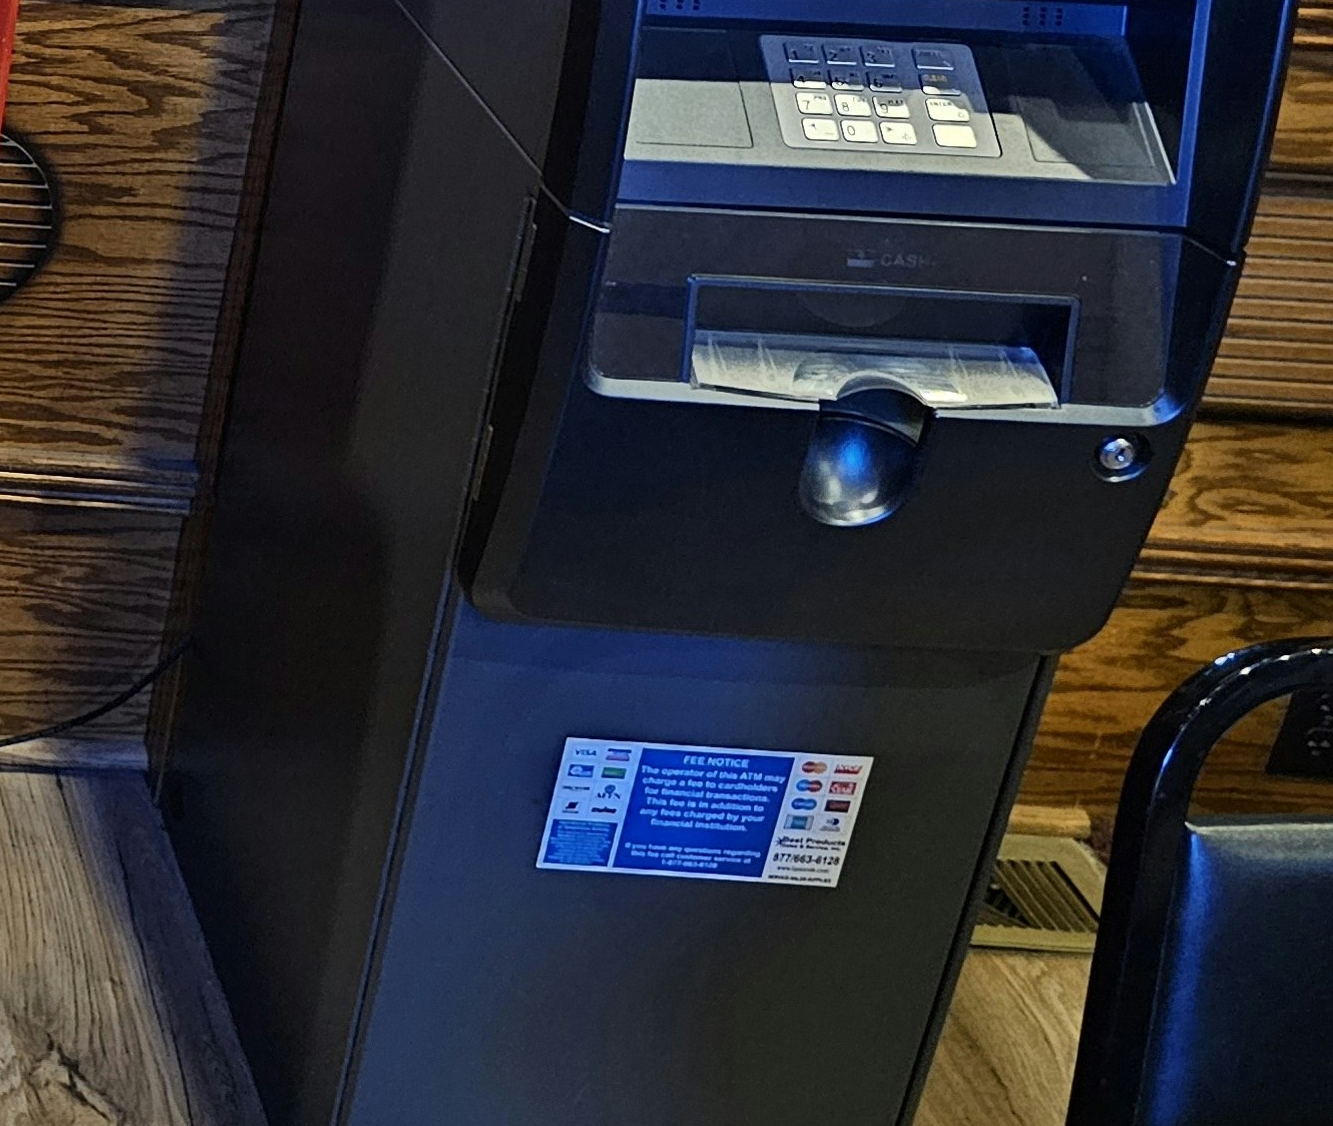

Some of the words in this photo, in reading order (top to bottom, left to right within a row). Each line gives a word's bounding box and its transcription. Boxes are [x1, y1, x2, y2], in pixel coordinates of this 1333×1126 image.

[802, 99, 810, 110] 7
[841, 101, 850, 111] 8
[881, 103, 889, 114] 9
[847, 125, 856, 136] 0
[684, 755, 706, 765] FEE
[707, 757, 750, 769] NOTICE
[641, 765, 659, 774] The
[661, 767, 704, 778] operator
[706, 770, 718, 778] of
[719, 771, 738, 780] this
[740, 772, 763, 781] ATM
[764, 775, 786, 784] may
[642, 777, 677, 787] charge
[687, 779, 703, 788] fee
[705, 781, 716, 789] to
[718, 781, 779, 792] cardholders
[644, 787, 659, 795] for
[661, 788, 704, 798] financial
[646, 797, 667, 805] This
[669, 799, 685, 807] fee
[711, 802, 751, 811] addition
[754, 804, 764, 812] to
[639, 808, 658, 817] any
[660, 809, 681, 817] fees
[683, 810, 725, 820] charged
[727, 812, 739, 822] by
[741, 815, 765, 823] your
